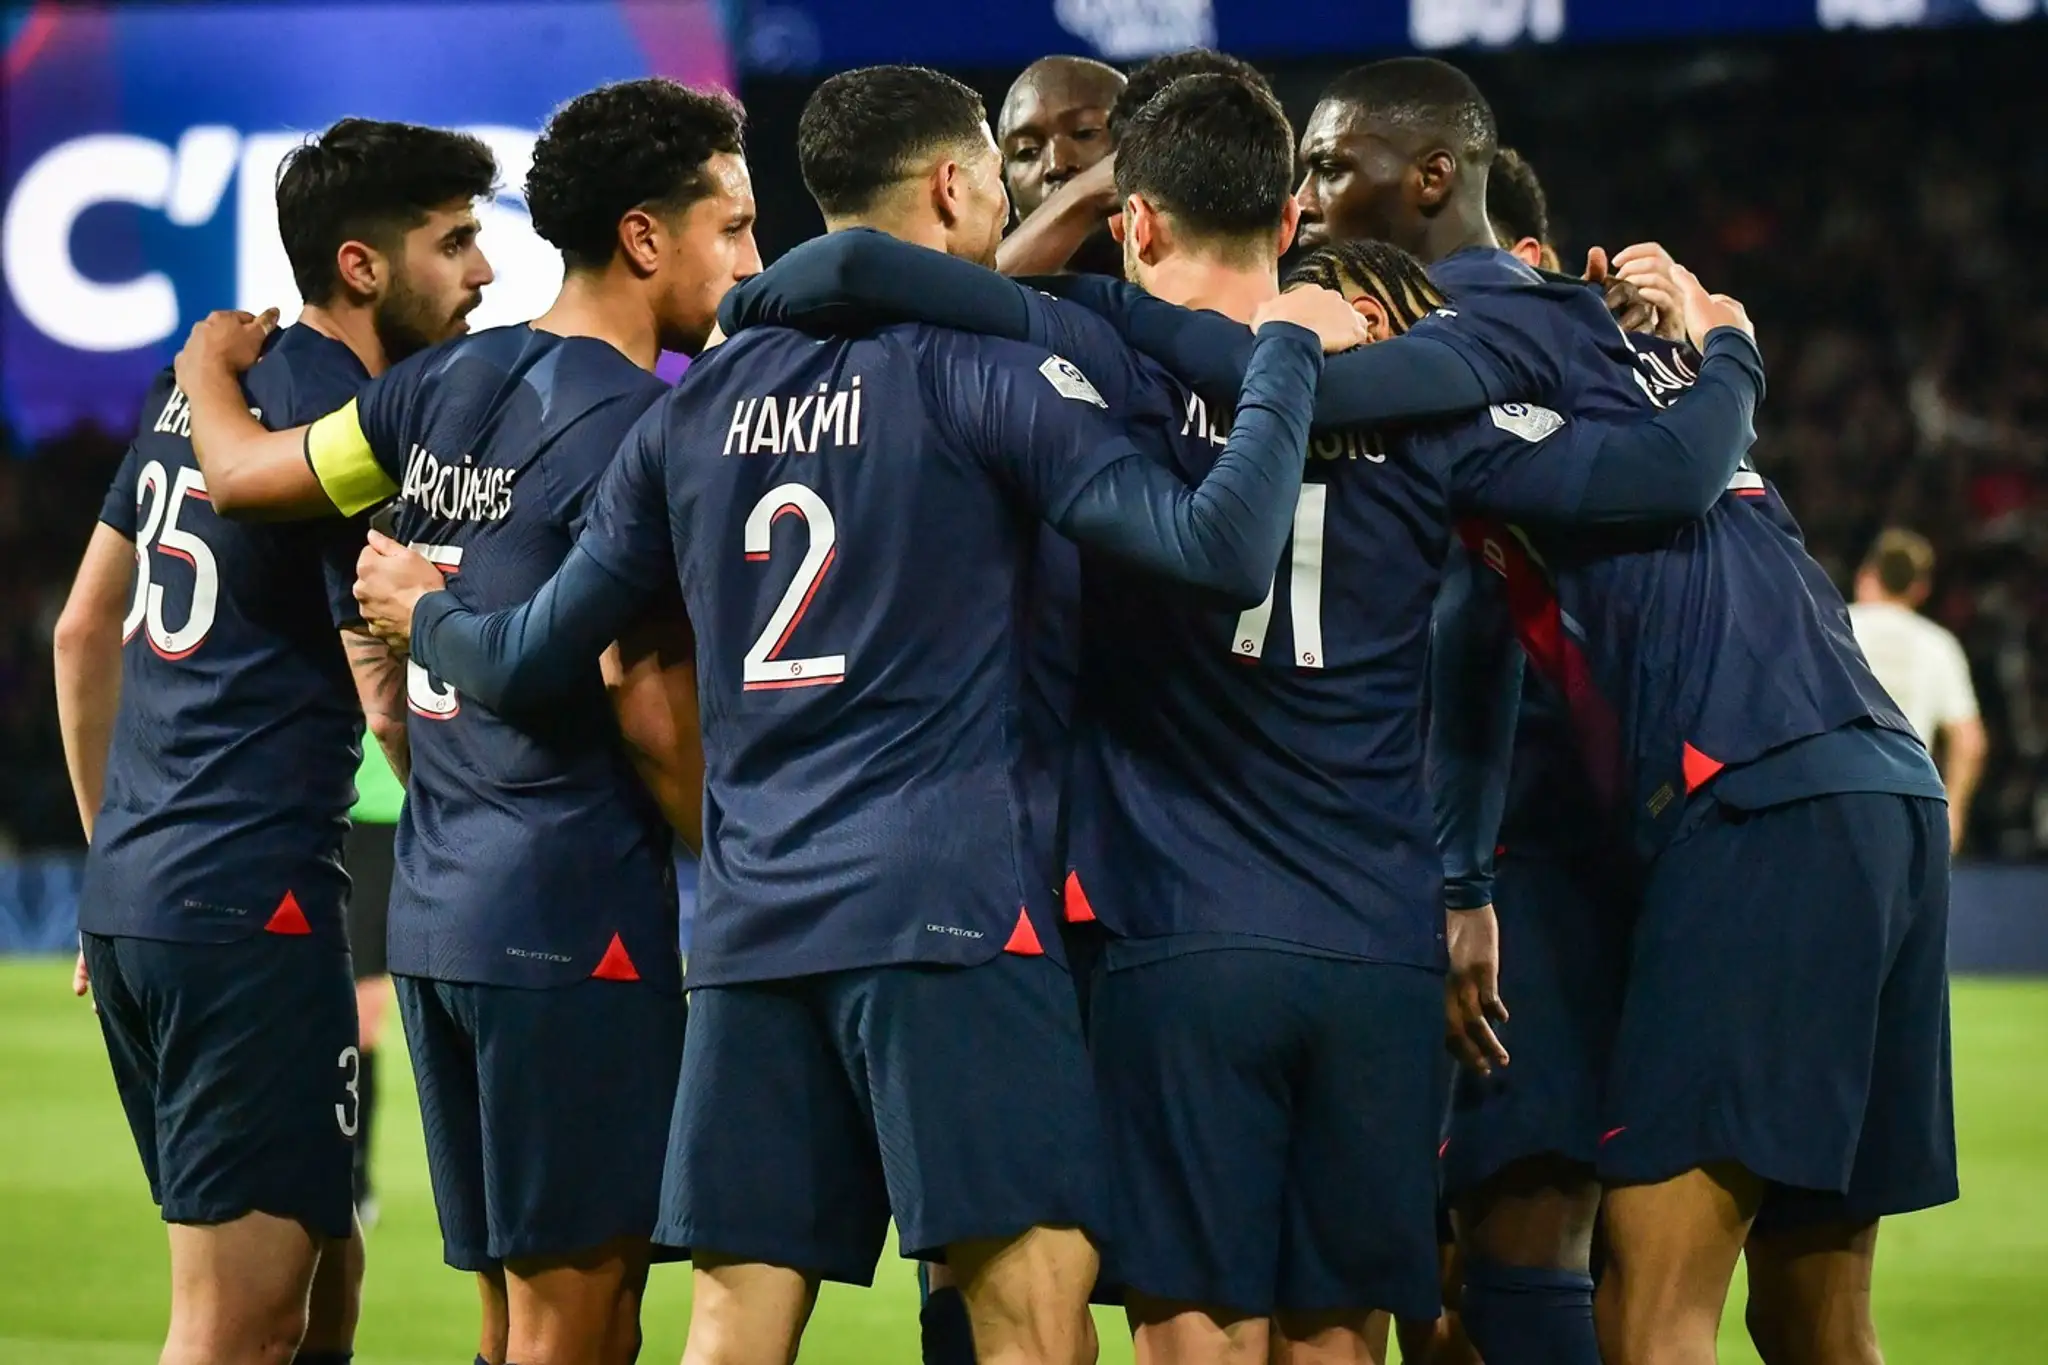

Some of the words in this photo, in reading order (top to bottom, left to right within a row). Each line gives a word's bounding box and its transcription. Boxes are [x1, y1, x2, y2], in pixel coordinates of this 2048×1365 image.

[122, 460, 219, 661] 35
[743, 482, 846, 691] 2
[334, 1045, 360, 1137] 3
